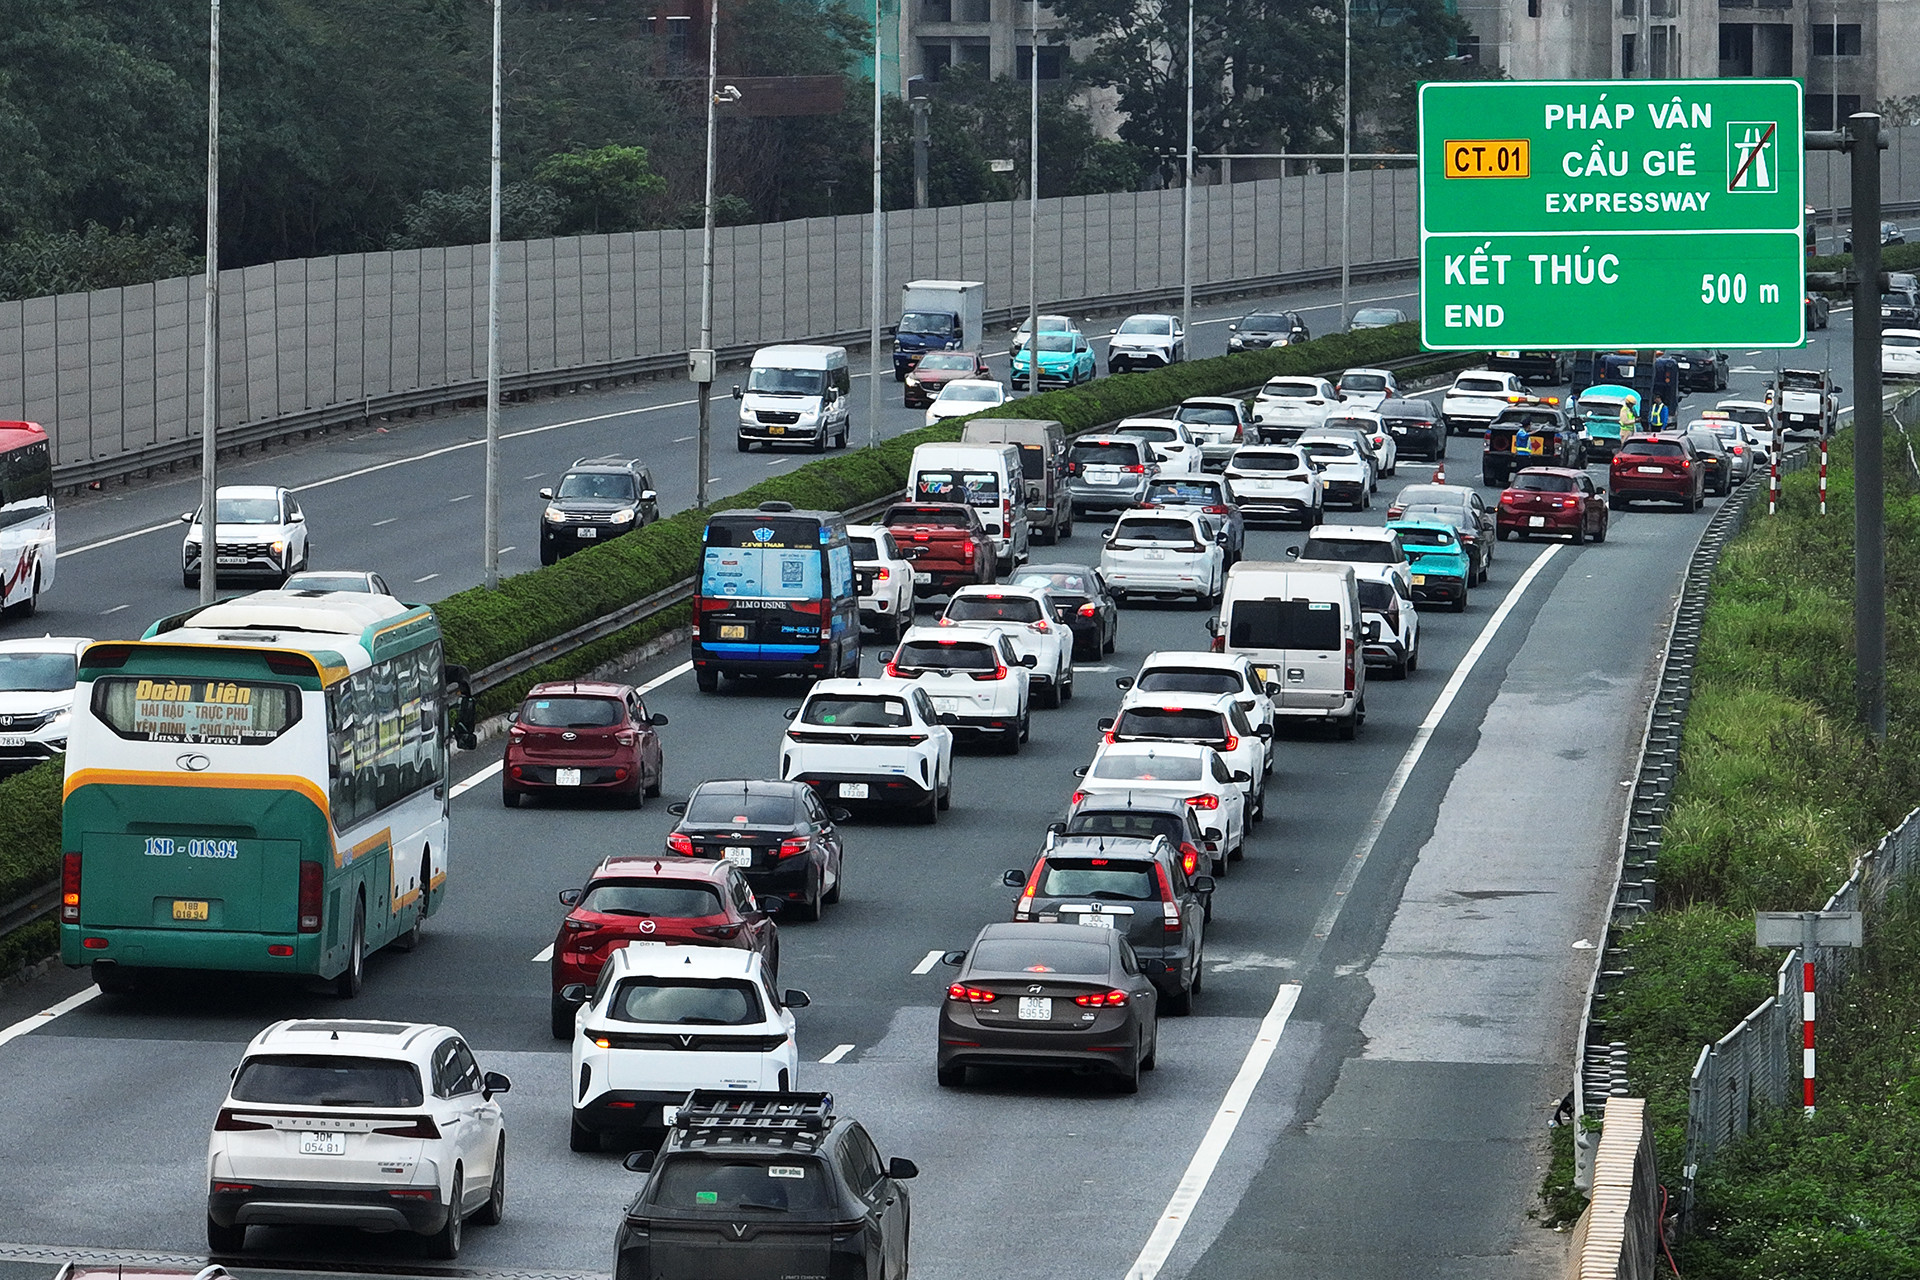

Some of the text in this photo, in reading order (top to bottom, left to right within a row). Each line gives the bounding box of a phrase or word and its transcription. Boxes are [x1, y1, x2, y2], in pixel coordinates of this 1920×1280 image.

[1545, 94, 1712, 130] PHÁP VÂN
[1454, 146, 1521, 172] CT.01
[1562, 140, 1697, 177] CẦU GIẼ
[1545, 192, 1711, 213] EXPRESSWAY
[1444, 242, 1620, 285] KẾT THÚC
[1700, 273, 1780, 304] 500 m
[1444, 305, 1505, 328] END
[136, 679, 251, 705] Đoàn Liên
[144, 837, 174, 856] 18B
[188, 839, 239, 859] 018.94
[277, 1119, 369, 1128] HYUNDAI
[304, 1143, 339, 1153] 054.81
